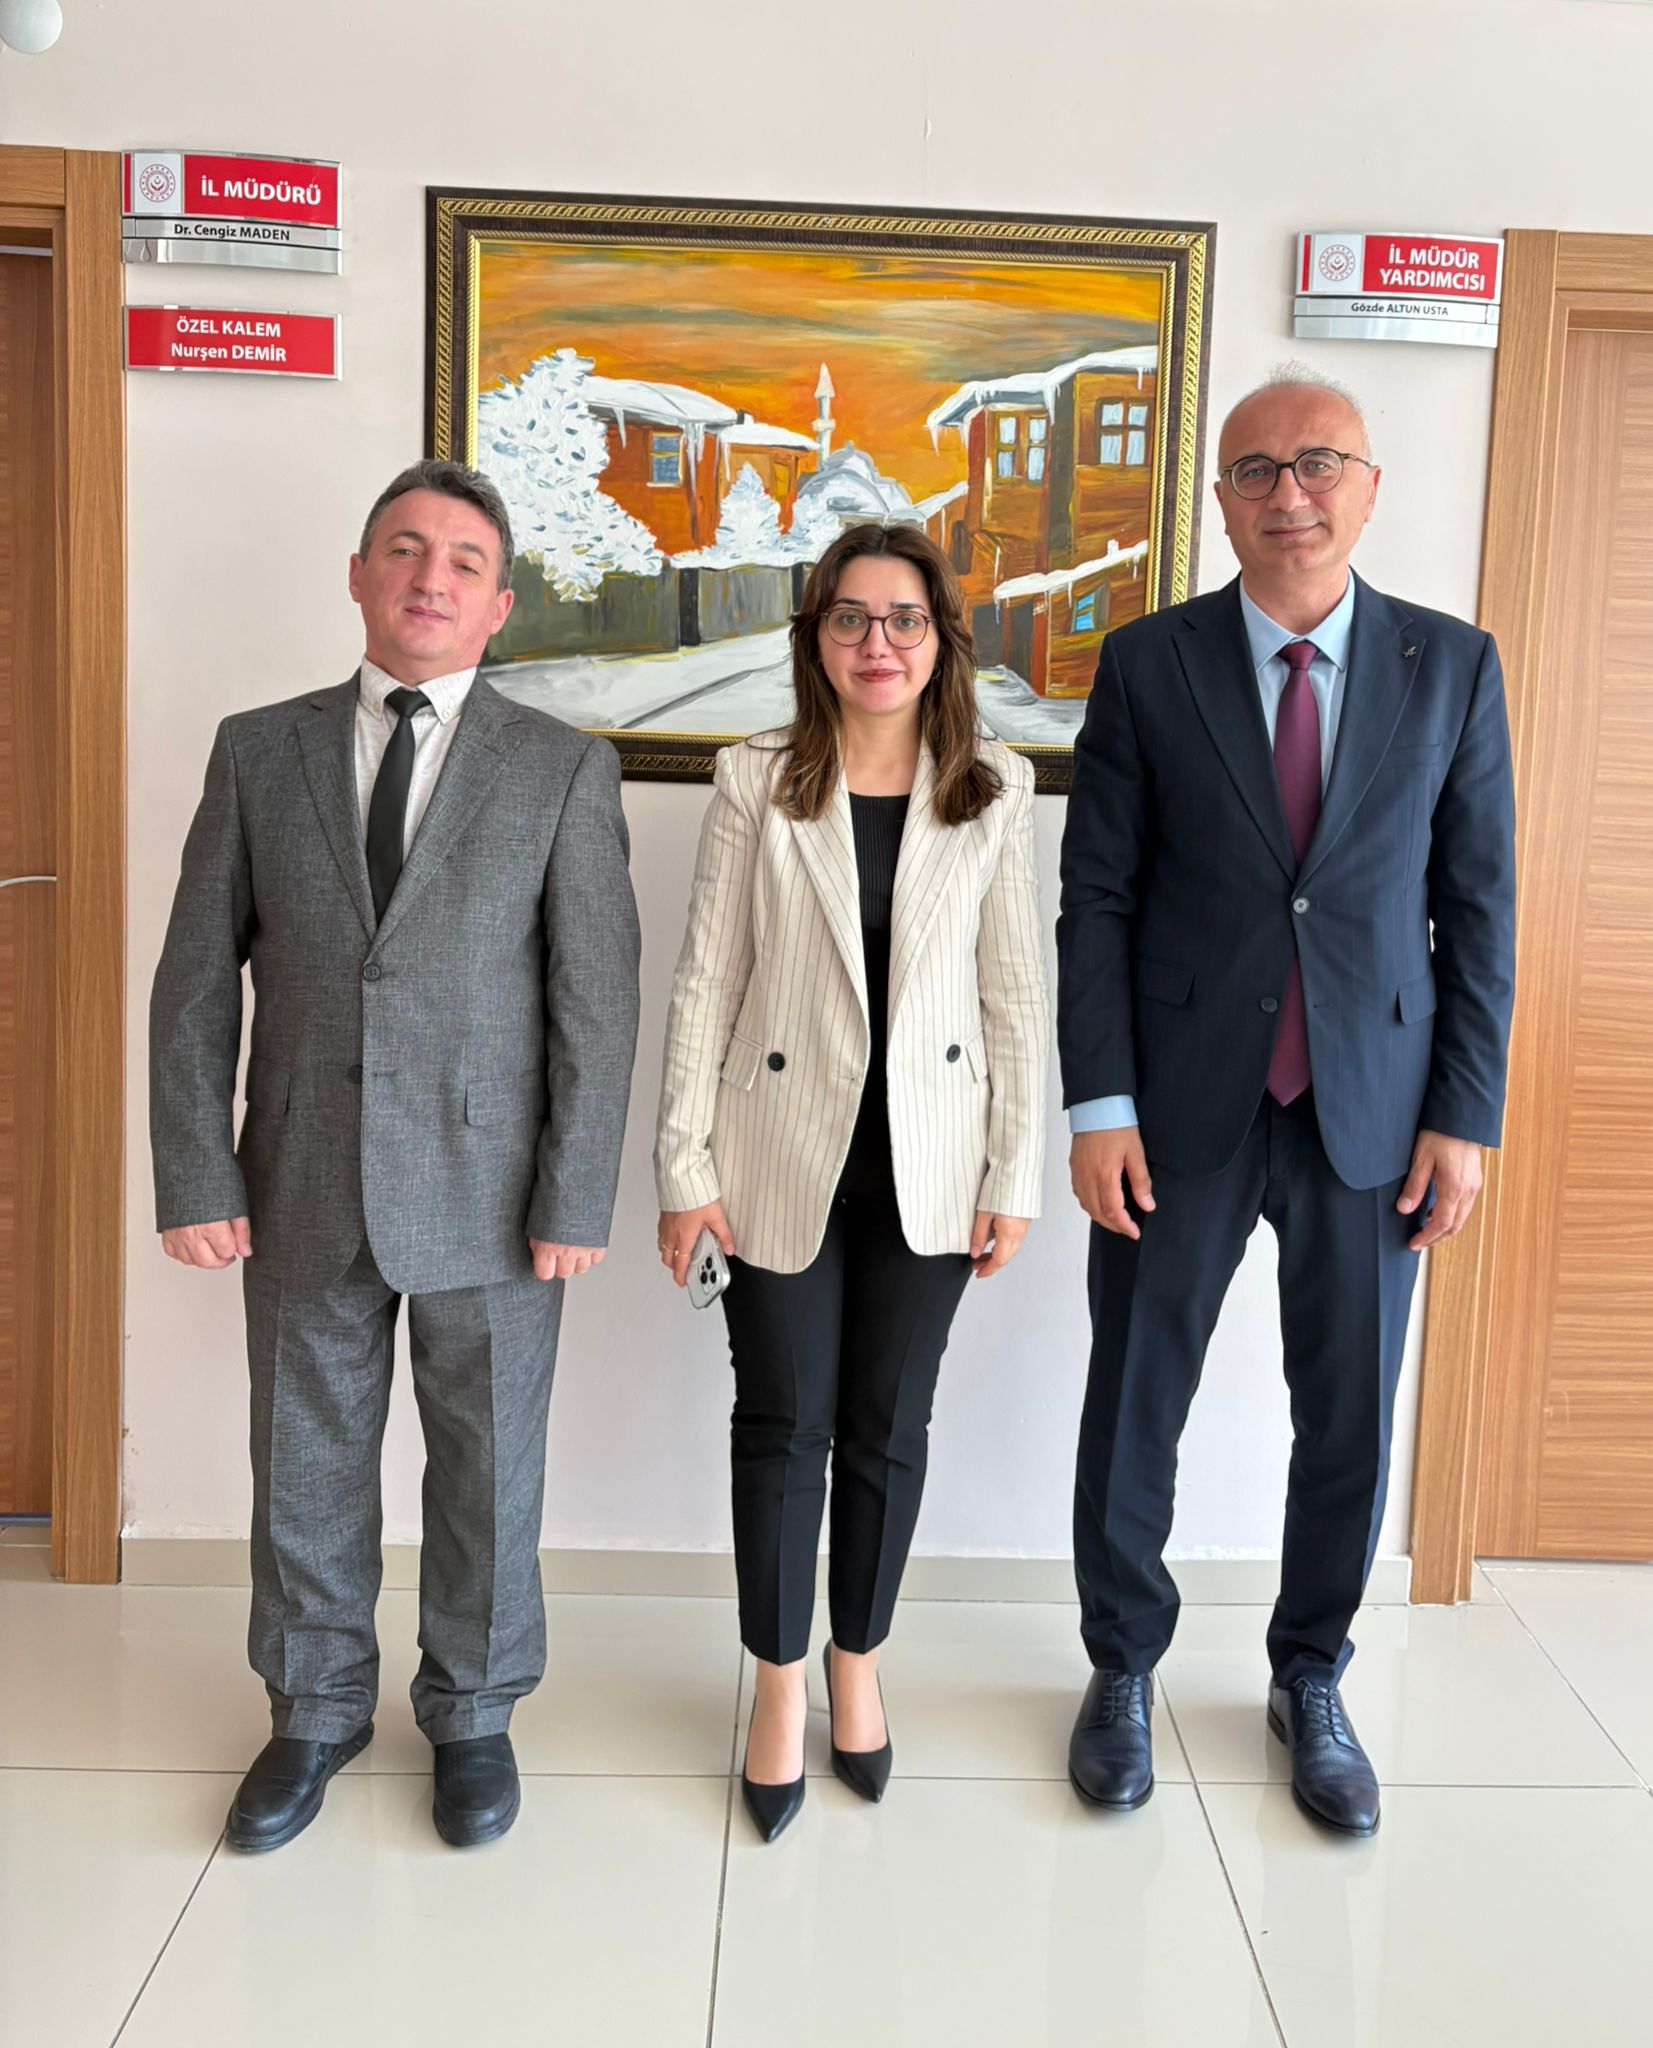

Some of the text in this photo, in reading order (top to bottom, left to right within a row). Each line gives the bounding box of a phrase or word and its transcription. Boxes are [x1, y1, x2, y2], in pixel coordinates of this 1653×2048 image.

[201, 175, 321, 205] İL MÜDÜRÜ
[174, 224, 290, 241] Dr. Cengiz MADEN
[1389, 244, 1479, 269] İL MÜDÜR
[1380, 269, 1485, 291] YARDIMCISI
[1351, 302, 1448, 315] Gözde ALTUN USTA
[176, 316, 281, 337] ÖZEL KALEM
[171, 343, 286, 362] Nurşen DEMİR
